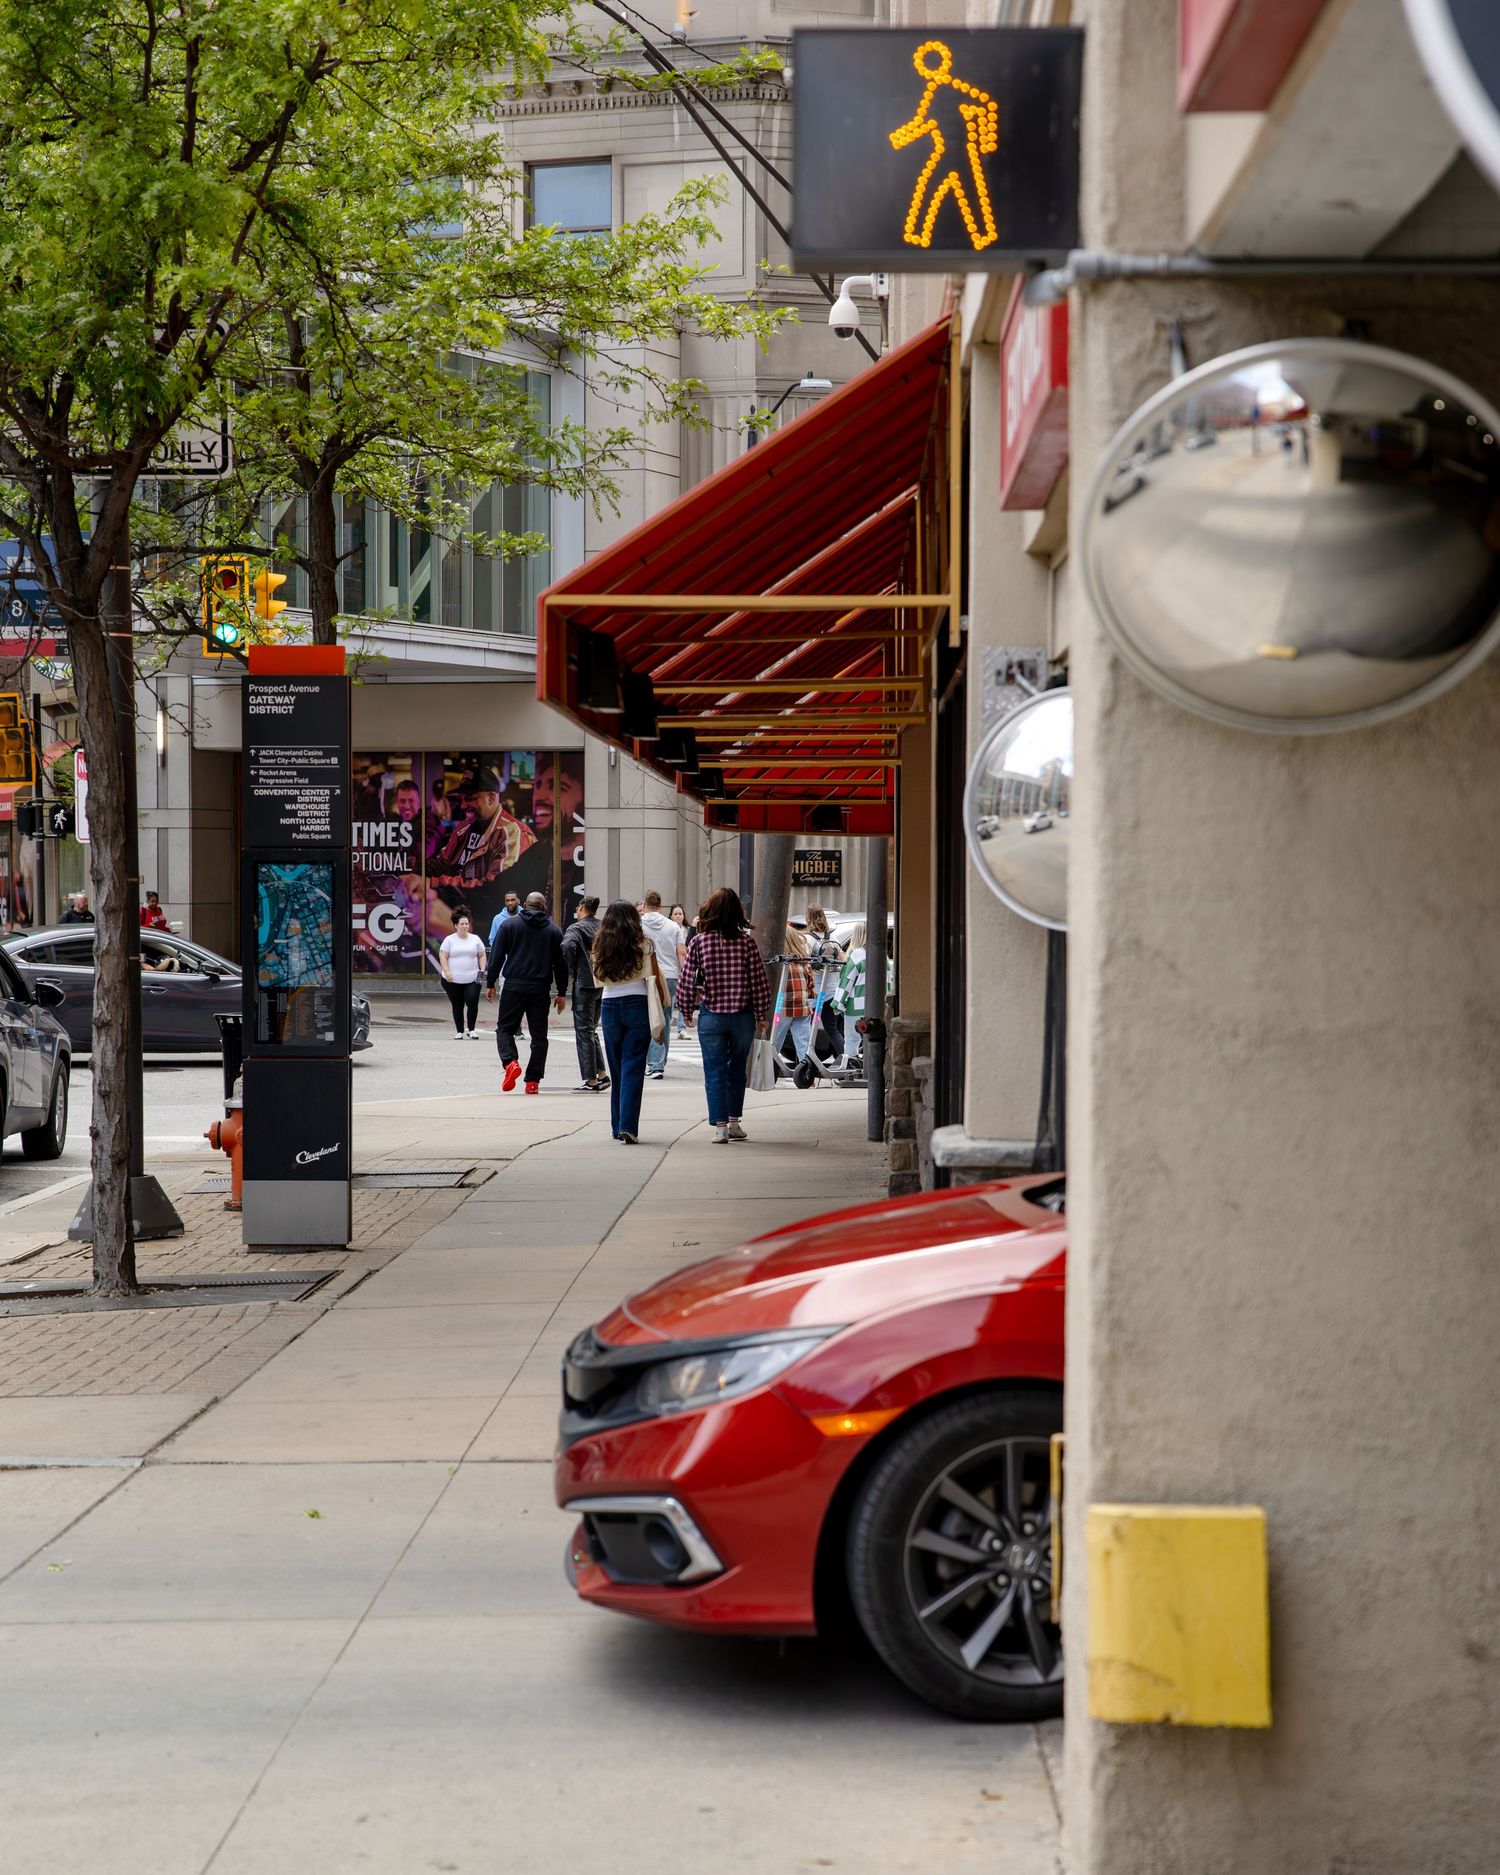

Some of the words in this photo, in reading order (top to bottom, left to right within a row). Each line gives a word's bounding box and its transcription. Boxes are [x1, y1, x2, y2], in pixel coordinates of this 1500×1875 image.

[152, 441, 217, 463] ONLY
[11, 600, 23, 617] 8
[248, 684, 287, 695] Prospect
[288, 684, 320, 693] Avenue
[249, 695, 296, 704] GATEWAY
[249, 705, 294, 714] DISTRICT
[310, 757, 330, 765] Square
[259, 777, 293, 785] Progressive
[310, 832, 331, 840] Square
[352, 822, 413, 847] TIMES
[806, 851, 822, 860] The
[792, 860, 839, 874] HIGBEE
[800, 873, 830, 884] Company
[295, 1142, 341, 1164] Cleveland
